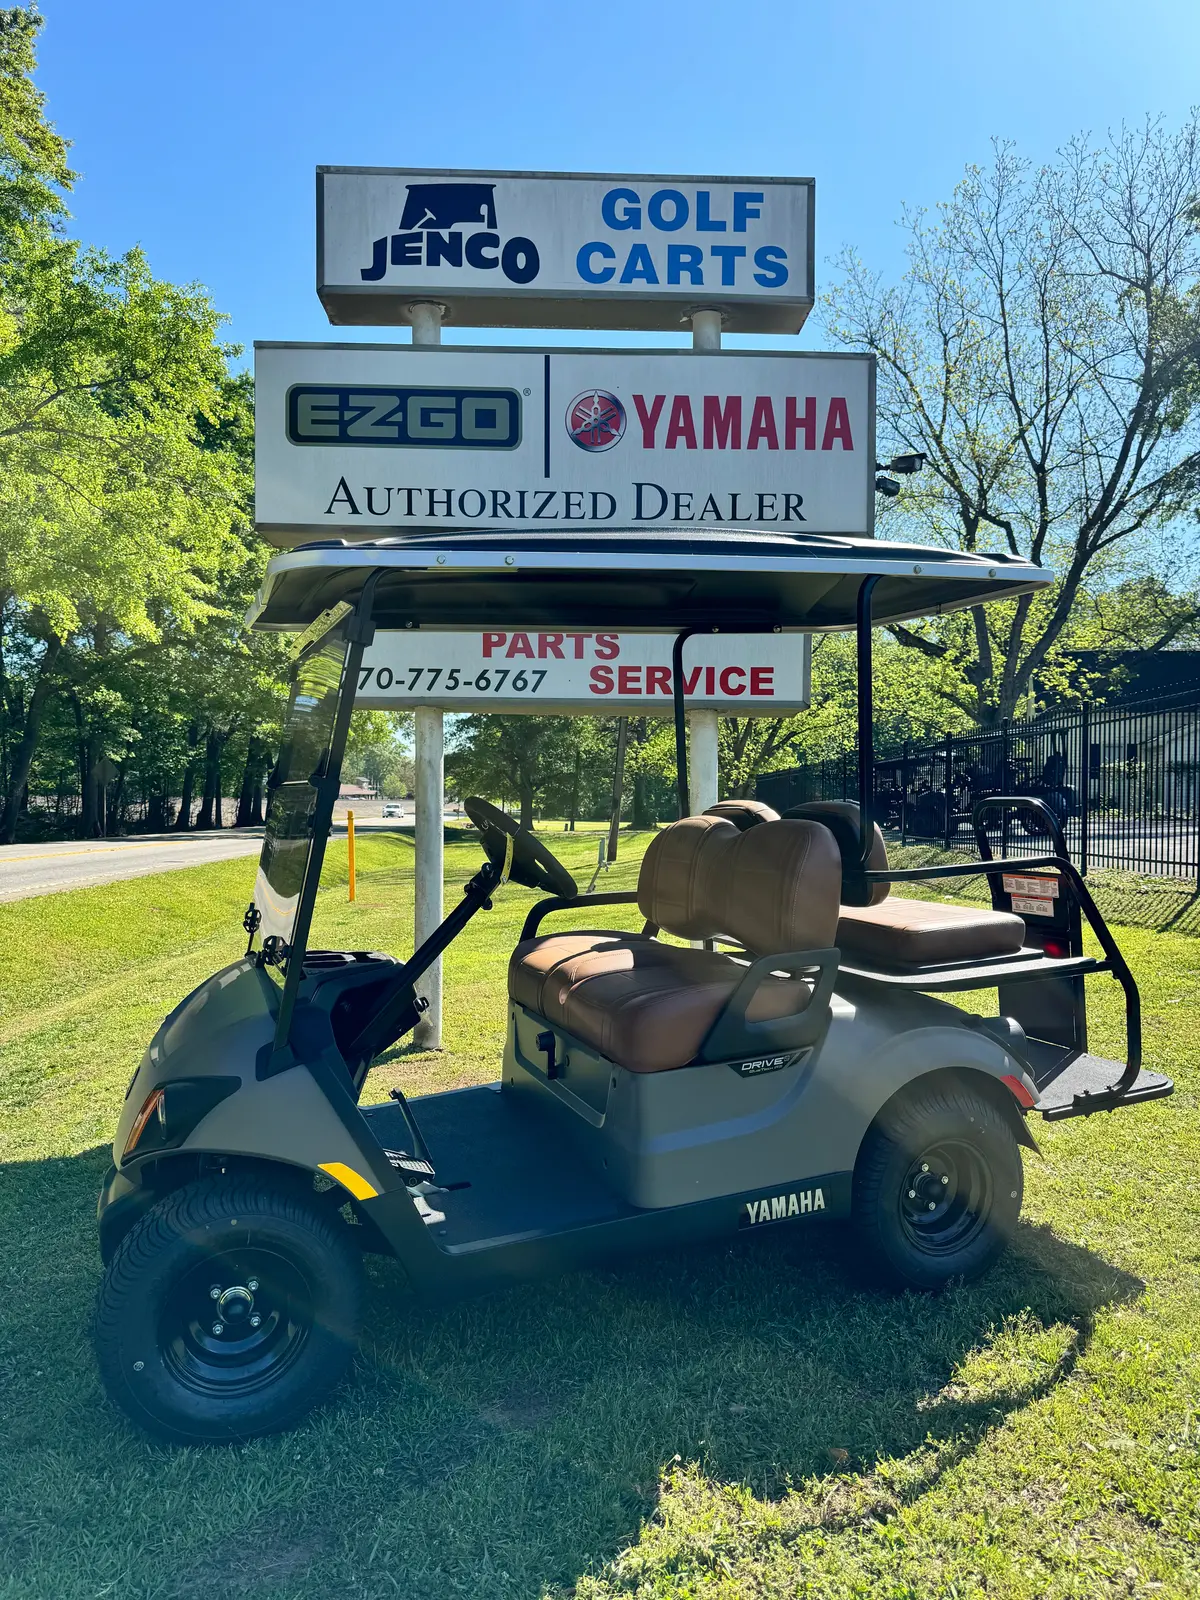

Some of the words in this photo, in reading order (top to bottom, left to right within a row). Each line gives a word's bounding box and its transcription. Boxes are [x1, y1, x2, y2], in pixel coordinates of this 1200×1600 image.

[601, 188, 764, 232] GOLF
[360, 231, 540, 284] JENCO
[576, 242, 789, 288] CARTS
[632, 394, 854, 451] YAMAHA
[324, 476, 617, 520] AUTHORIZED
[631, 482, 807, 522] DEALER
[482, 632, 620, 660] PARTS
[342, 667, 548, 693] 70-775-6767
[589, 665, 775, 696] SERVICE
[746, 1188, 825, 1224] YAMAHA
